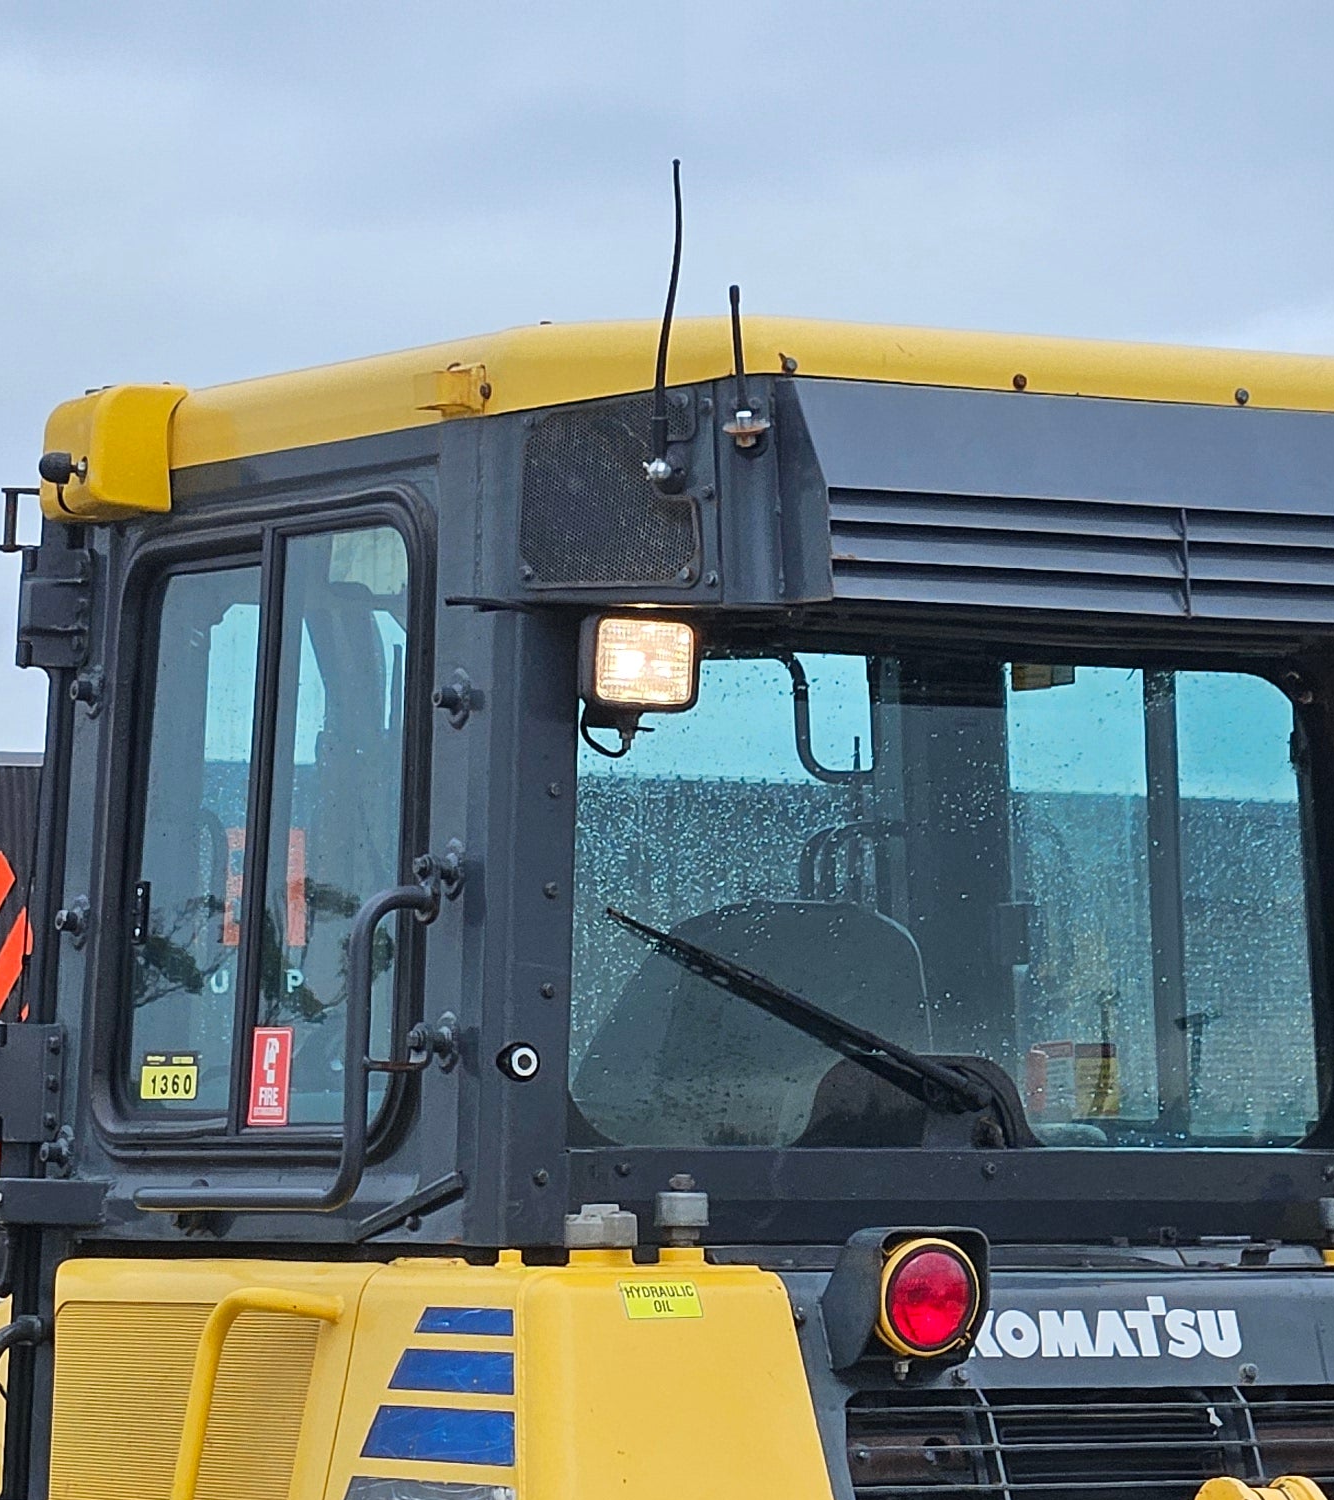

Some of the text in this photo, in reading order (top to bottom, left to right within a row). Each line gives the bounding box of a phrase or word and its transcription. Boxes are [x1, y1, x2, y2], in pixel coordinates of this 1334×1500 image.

[152, 1074, 192, 1095] 1360
[259, 1087, 279, 1106] FIRE
[624, 1285, 694, 1298] HYDRAULIC
[653, 1299, 674, 1312] OIL
